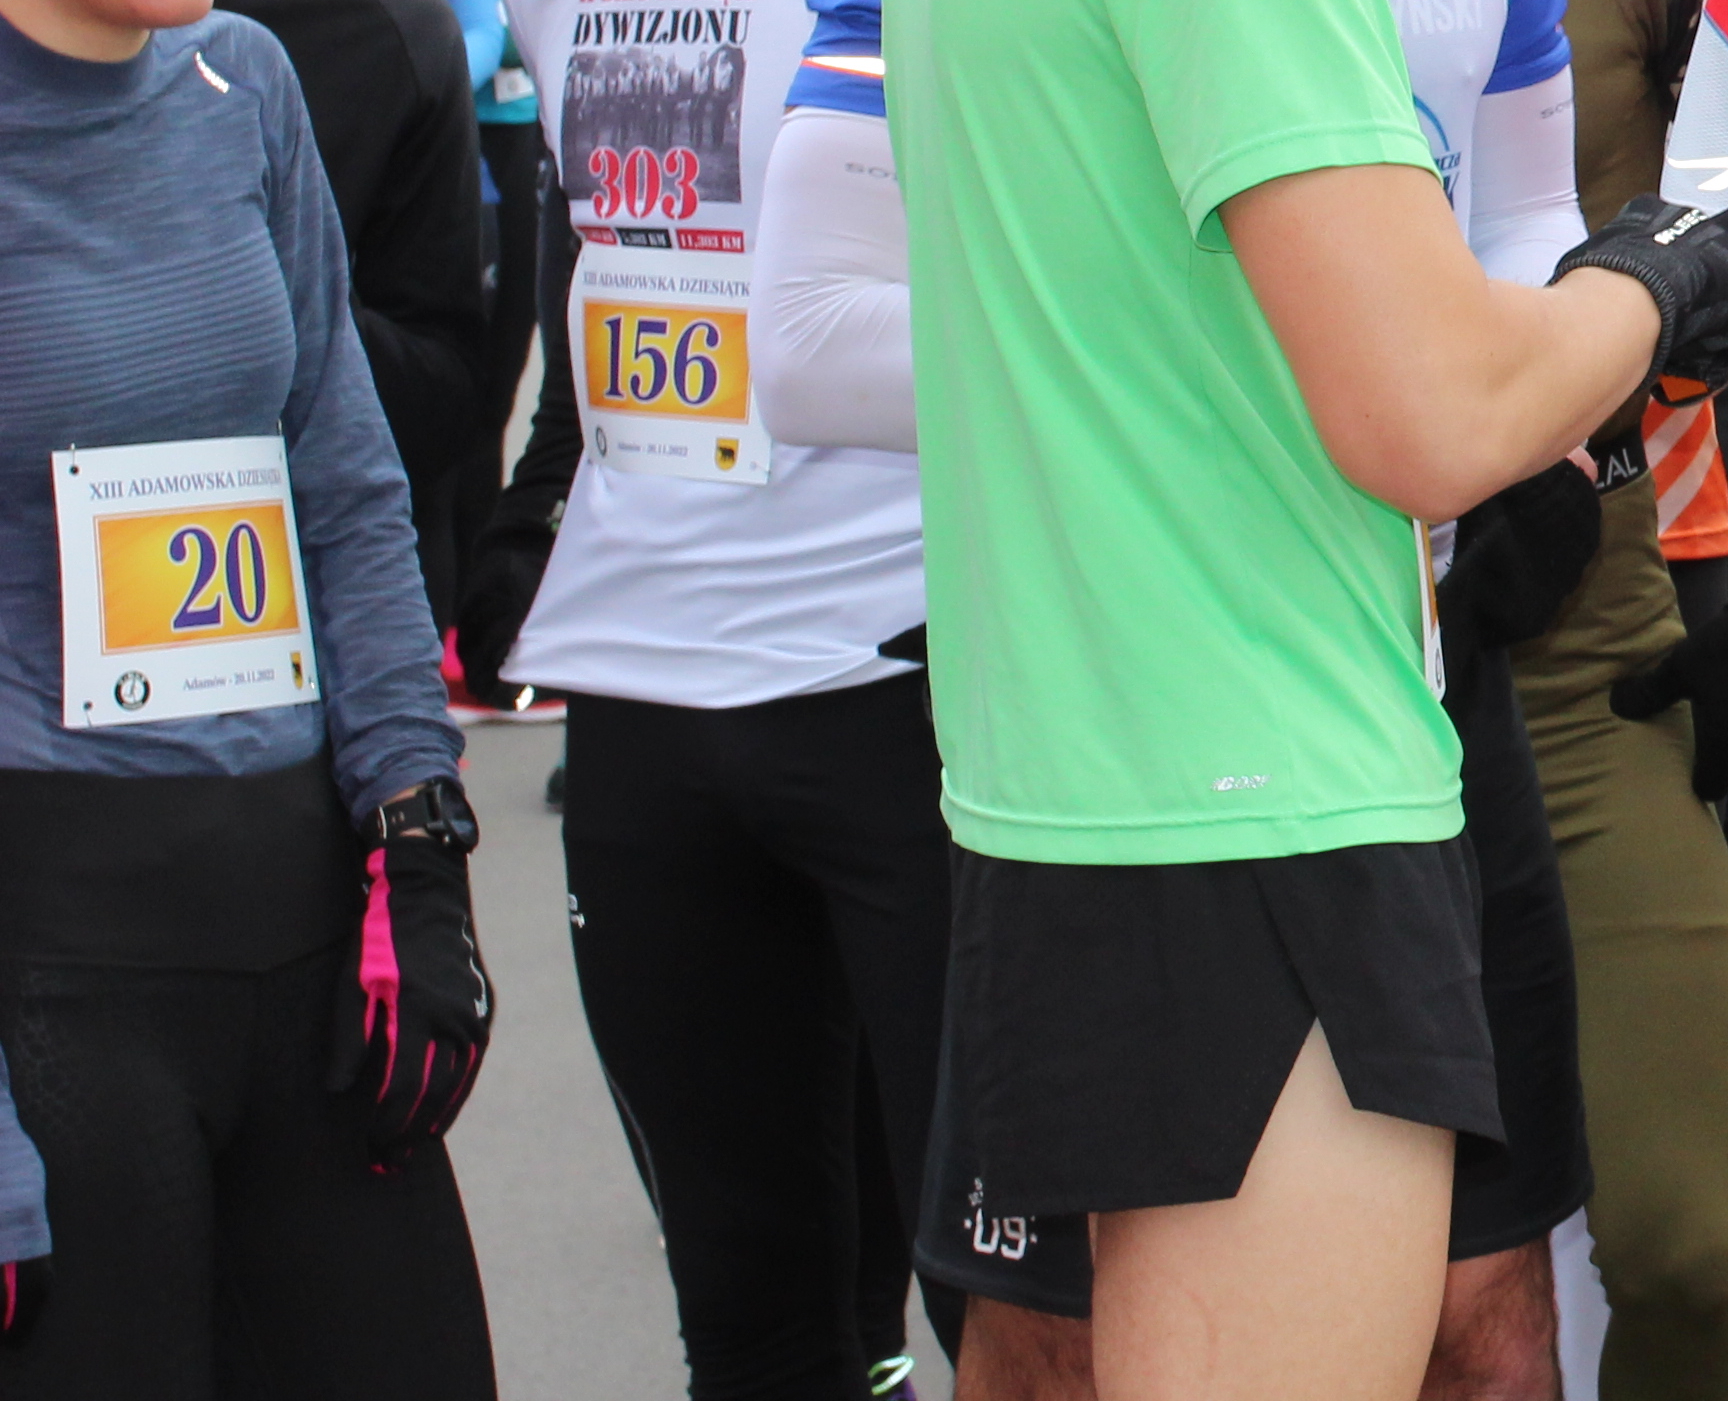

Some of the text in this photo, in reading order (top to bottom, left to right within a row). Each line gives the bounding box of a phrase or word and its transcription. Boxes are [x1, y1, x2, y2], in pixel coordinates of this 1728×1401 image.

[572, 8, 752, 46] DYWIZJONU
[589, 147, 699, 220] 303
[722, 235, 742, 251] KM
[599, 271, 676, 293] ADAMOWSKA
[678, 276, 751, 299] DZIESIĄTK
[604, 312, 720, 408] 156
[90, 480, 124, 500] XIII
[127, 471, 236, 498] ADAMOWSKA
[168, 520, 268, 631] 20
[183, 673, 227, 691] Adamów
